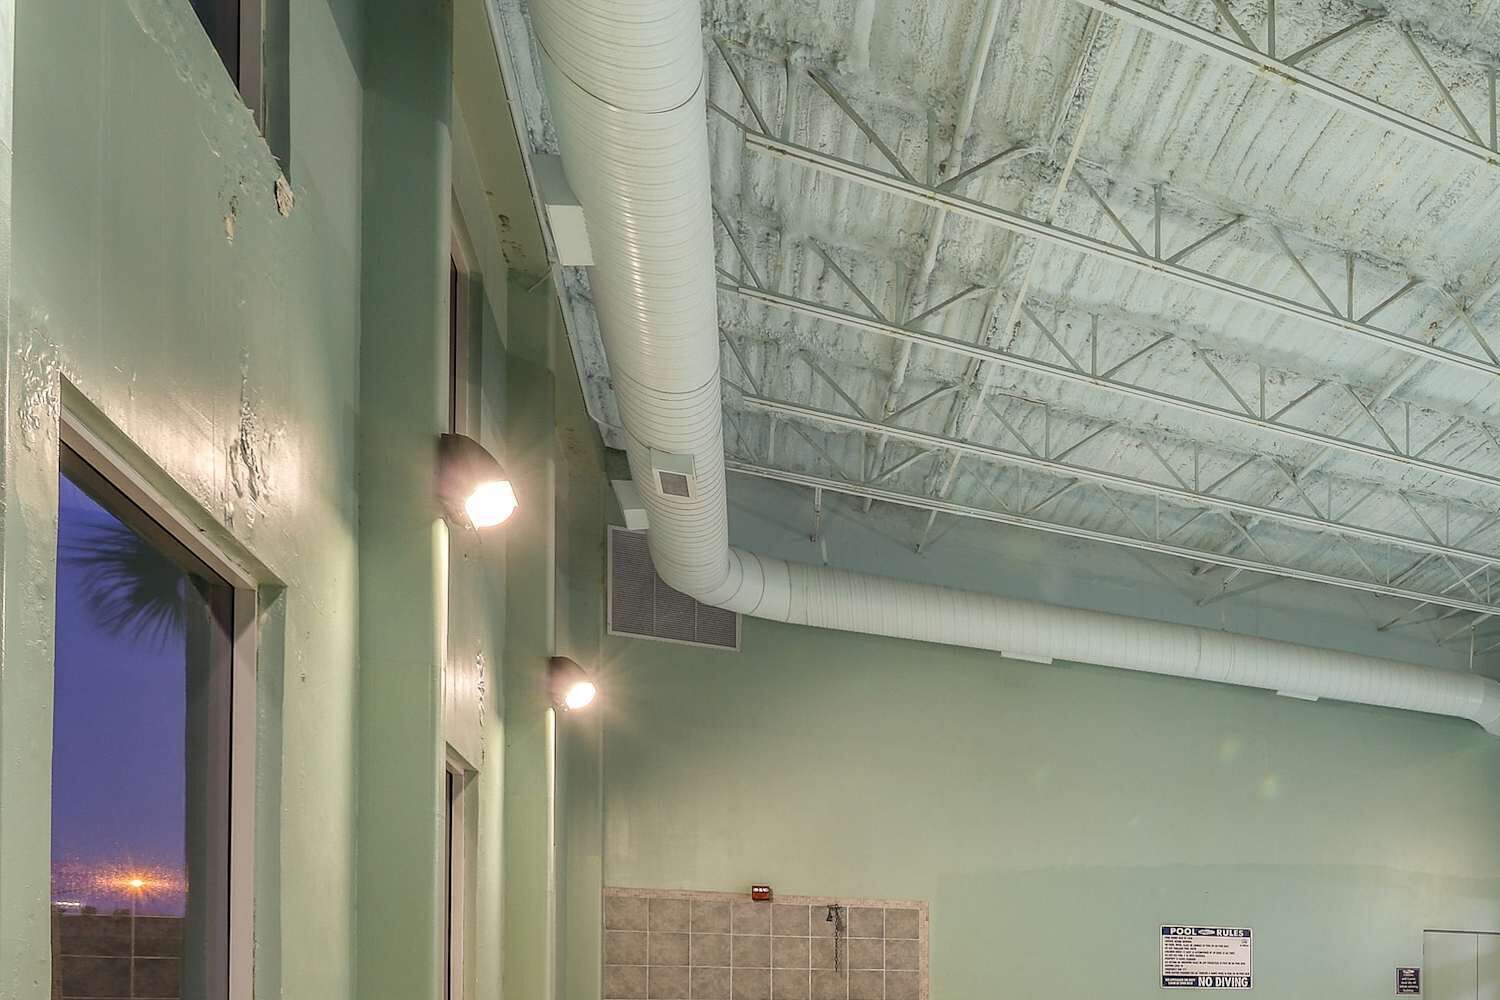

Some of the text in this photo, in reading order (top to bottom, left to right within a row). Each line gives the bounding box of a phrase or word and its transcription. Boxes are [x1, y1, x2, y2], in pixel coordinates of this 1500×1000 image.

[1170, 927, 1244, 937] POOL RULES
[1198, 976, 1213, 987] NO
[1215, 976, 1249, 987] DIVING
